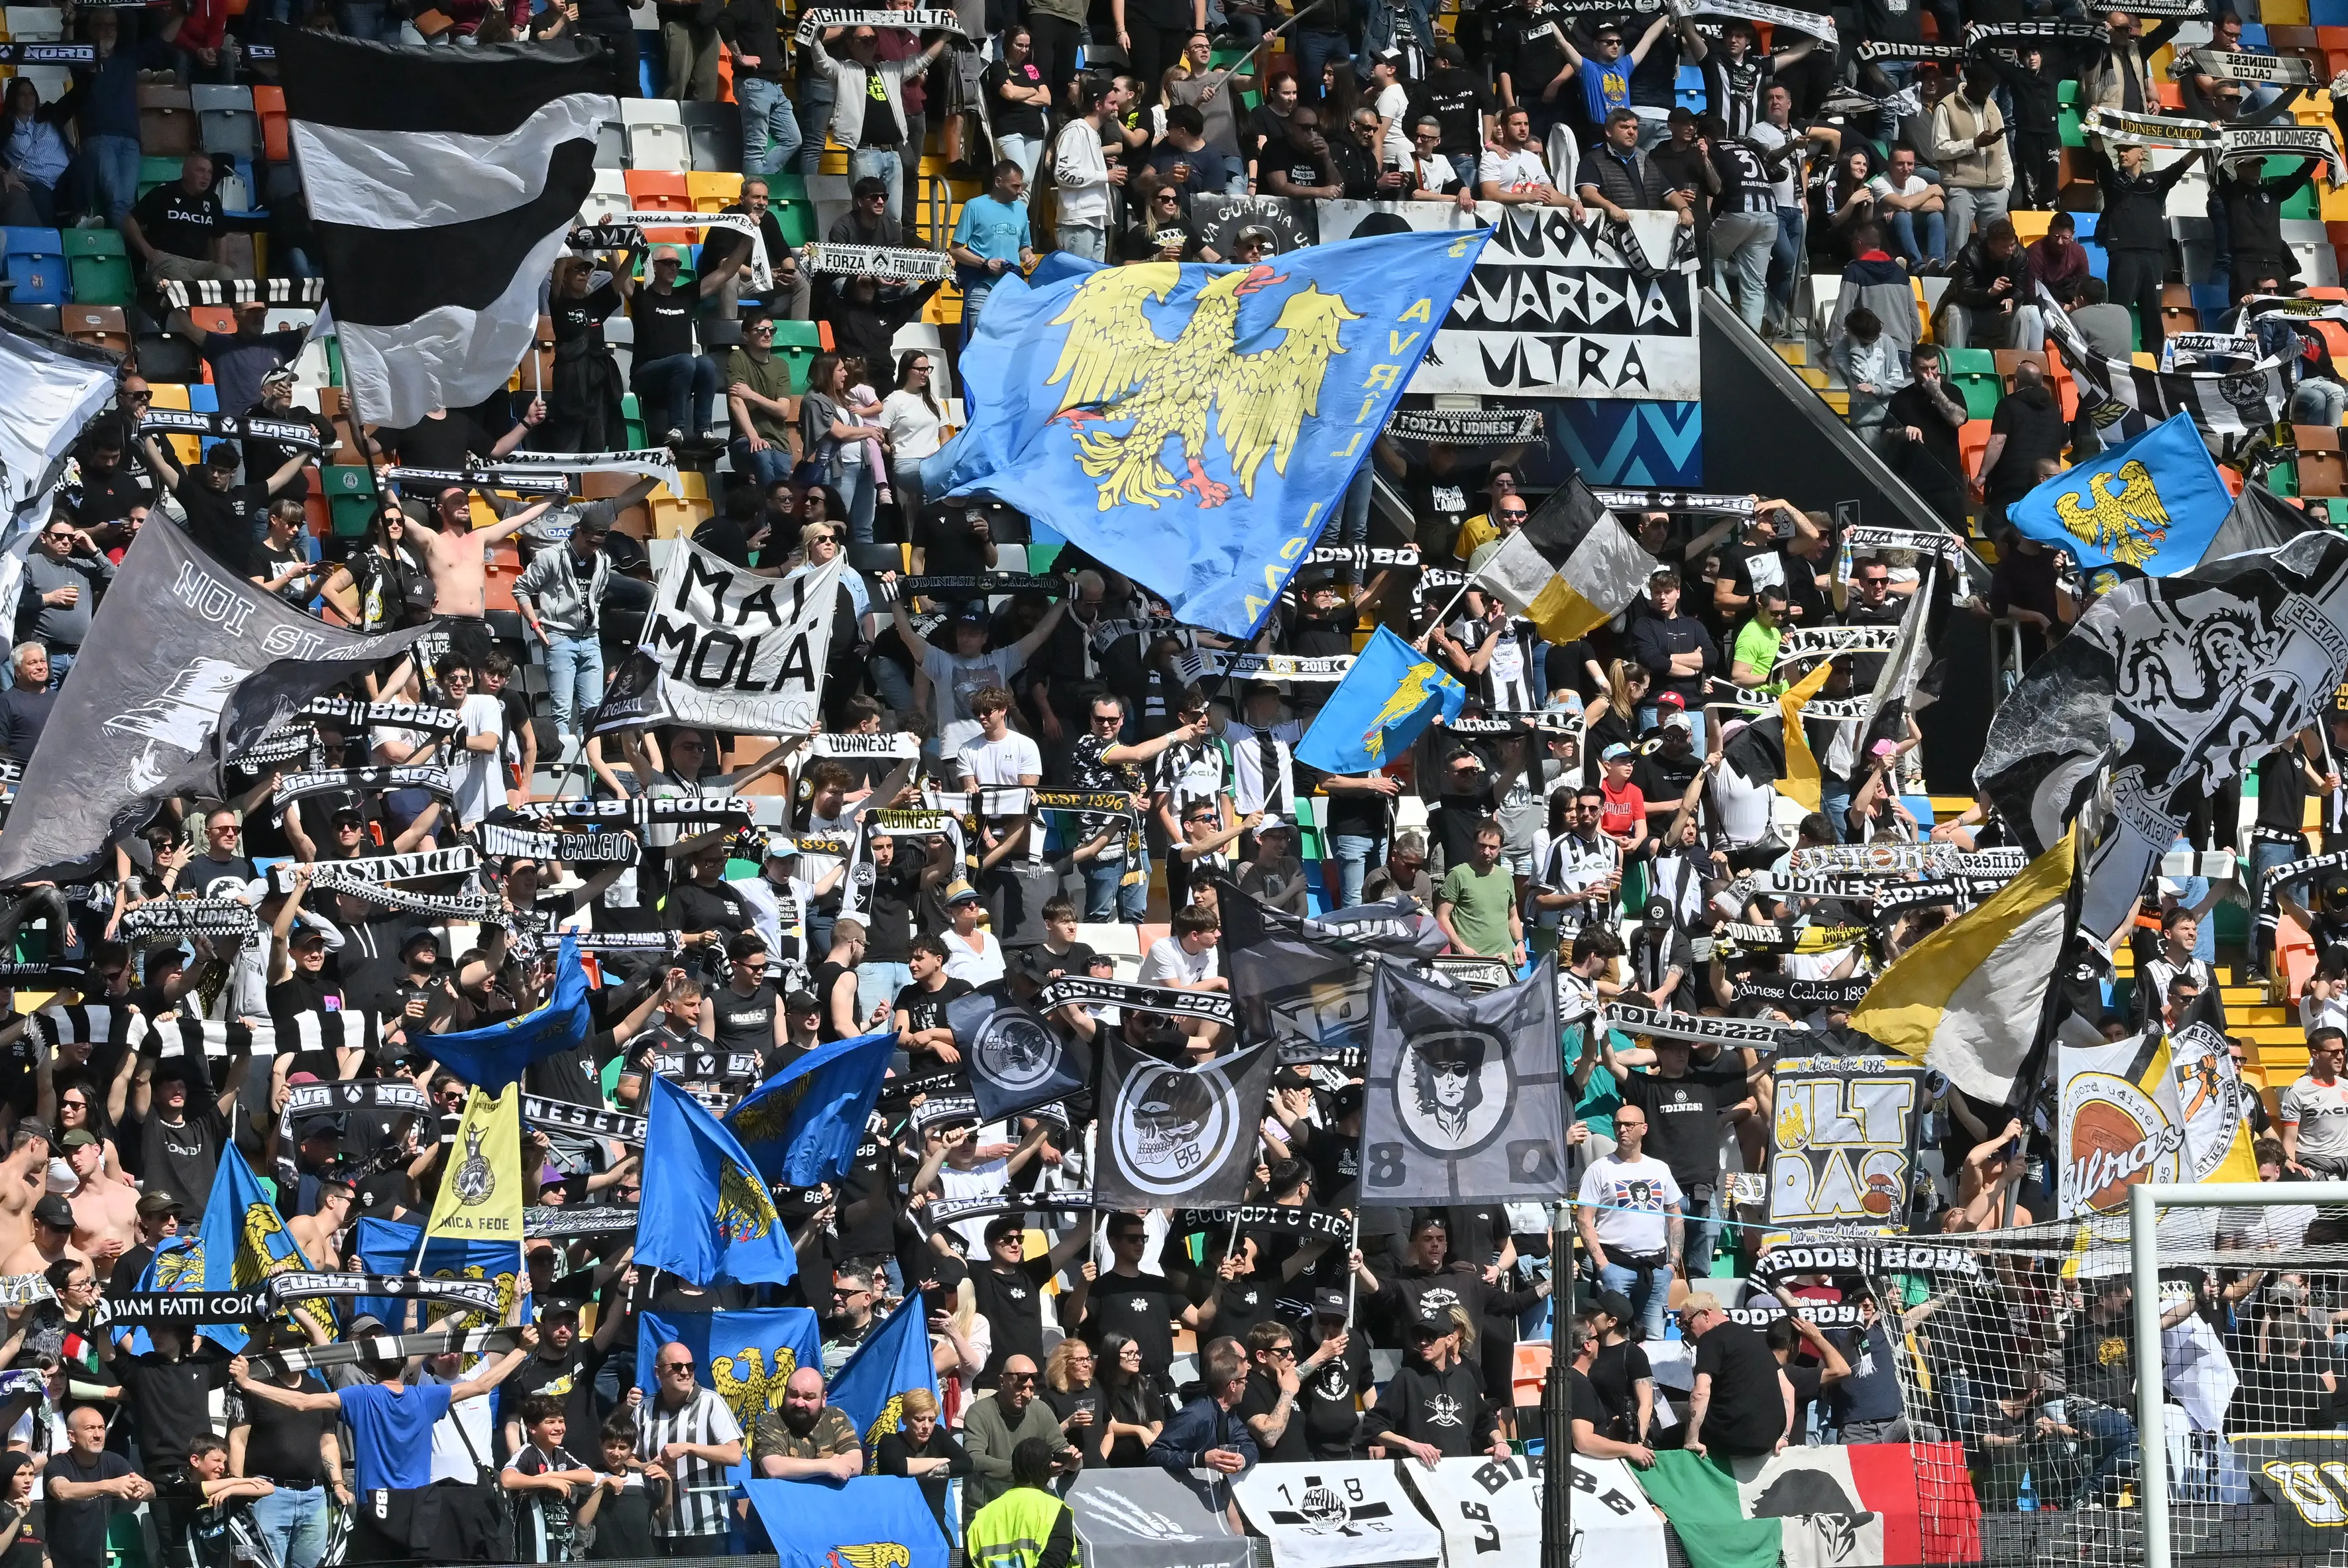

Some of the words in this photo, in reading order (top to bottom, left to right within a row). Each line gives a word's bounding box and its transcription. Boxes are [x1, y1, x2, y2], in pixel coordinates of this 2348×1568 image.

[24, 44, 94, 61] NORD
[2120, 119, 2162, 139] UDINESE
[2164, 127, 2202, 140] CALCIO
[2233, 130, 2271, 146] FORZA
[2274, 132, 2321, 147] UDINESE
[168, 209, 213, 225] DACIA
[626, 214, 672, 224] FORZA
[825, 253, 866, 270] FORZA
[893, 258, 936, 276] FRIULANI
[1477, 334, 1649, 392] ULTRA
[1400, 415, 1452, 436] FORZA
[1462, 421, 1516, 436] UDINESE
[909, 575, 976, 589] UDINESE
[997, 576, 1059, 590] CALCIO
[1301, 662, 1331, 673] 2016
[369, 703, 459, 731] BOYS
[828, 732, 897, 753] UDINESE
[1088, 795, 1127, 811] 1896
[875, 809, 945, 830] UDINESE
[484, 824, 559, 862] UDINESE
[561, 833, 631, 862] CALCIO
[124, 909, 177, 928] FORZA
[13, 963, 49, 975] D'ITALIA
[1789, 981, 1840, 1002] Calcio
[1843, 985, 1870, 1003] 189
[1605, 1002, 1783, 1042] TOLMEZZ
[1809, 1054, 1859, 1072] dicembre
[1862, 1059, 1886, 1074] 1995
[1776, 1078, 1916, 1151] ULT
[478, 1217, 510, 1231] FEDE
[114, 1300, 152, 1317] SIAM
[160, 1298, 204, 1316] FATTI
